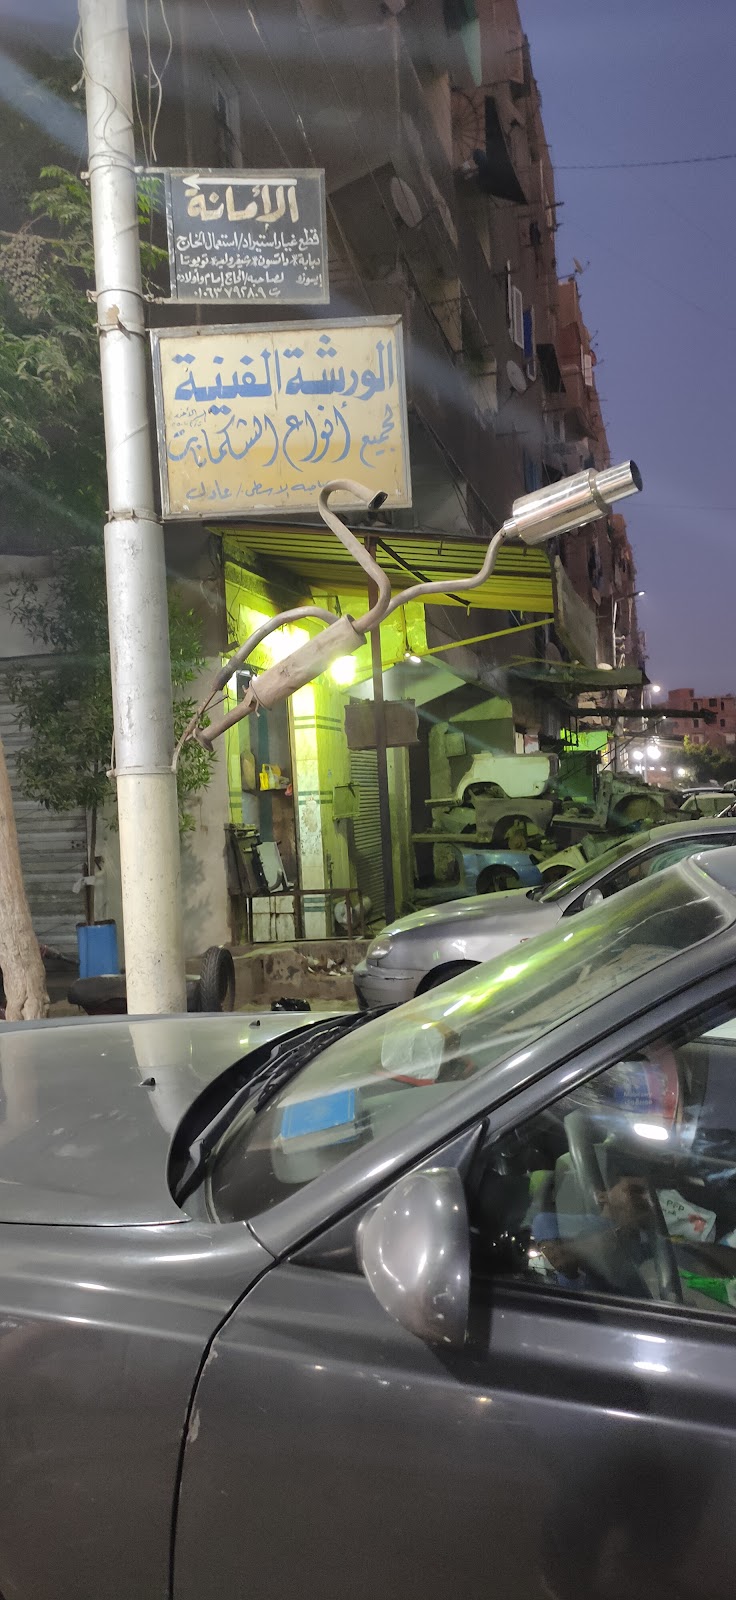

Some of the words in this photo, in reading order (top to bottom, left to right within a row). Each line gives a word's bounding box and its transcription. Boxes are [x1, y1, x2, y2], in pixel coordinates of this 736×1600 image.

[184, 184, 300, 224] الأمانة
[176, 230, 206, 251] الخارج
[275, 231, 298, 252] غيار
[298, 227, 320, 251] قطع
[180, 253, 209, 269] تويوتا
[258, 252, 289, 269] داتسون
[298, 252, 321, 270] دبابة
[268, 287, 281, 297] ت
[283, 334, 395, 401] الورشة
[172, 348, 282, 416] الفنية
[283, 400, 351, 472] أنواع
[359, 403, 395, 469] لجميع
